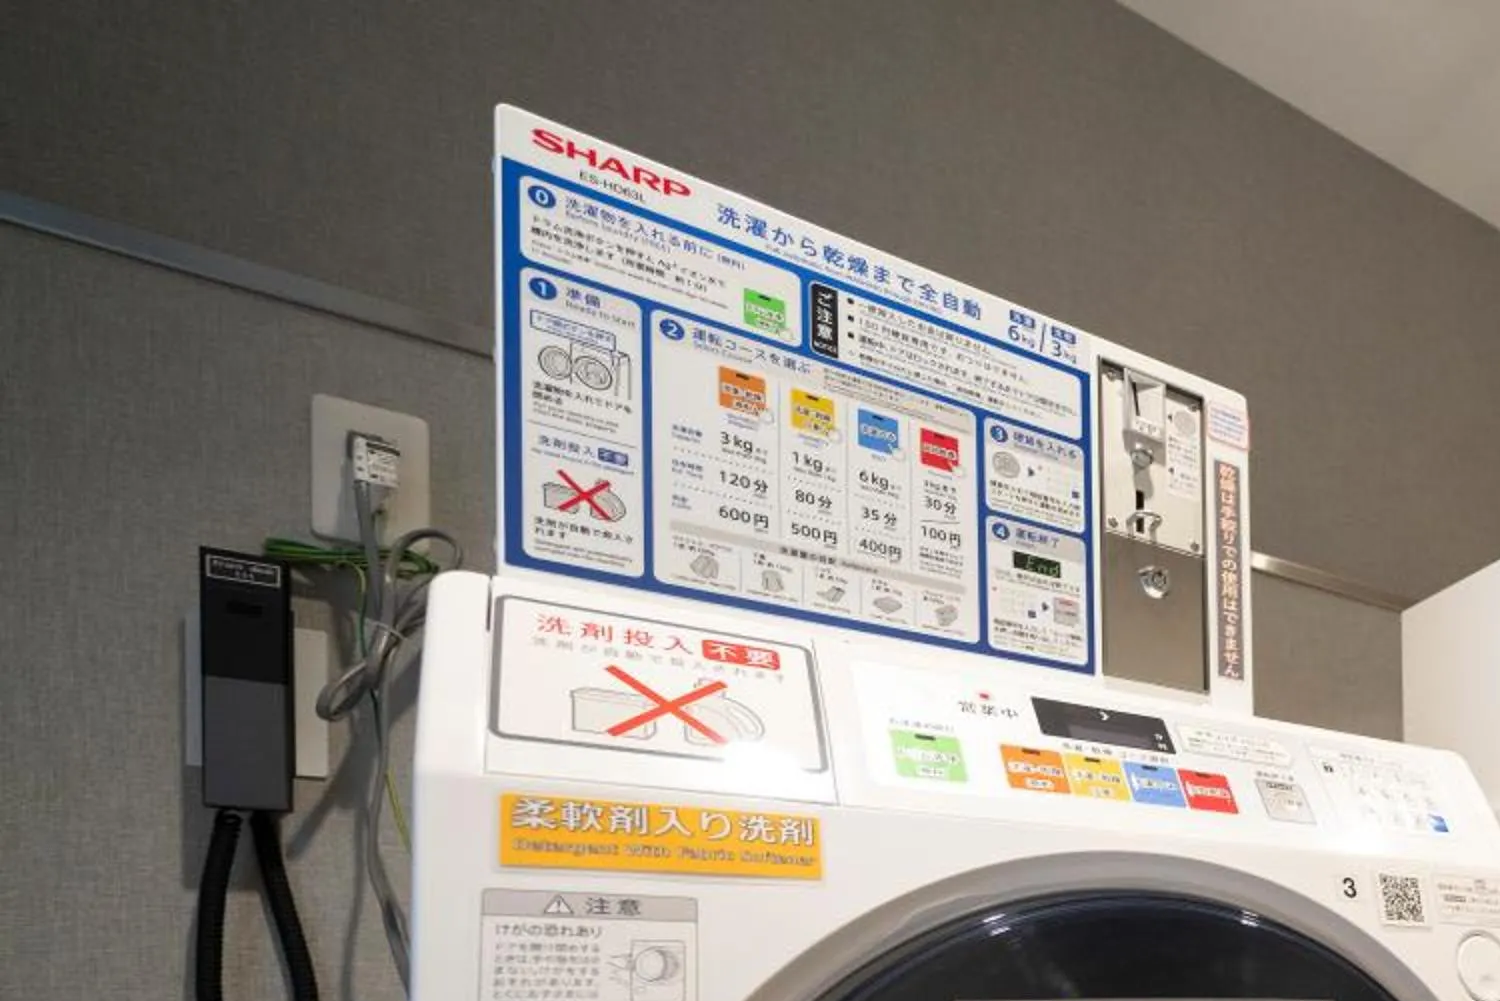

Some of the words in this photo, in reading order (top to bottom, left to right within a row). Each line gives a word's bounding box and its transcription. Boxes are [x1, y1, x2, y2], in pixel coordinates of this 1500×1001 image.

[532, 125, 690, 203] SHARP
[564, 194, 713, 260] 洗濯物を入れる前に
[716, 201, 981, 322] 洗濯から乾燥まで全自動
[566, 287, 600, 310] 準備
[816, 287, 832, 341] ご注意
[691, 326, 810, 376] 運転コースを選ぶ
[719, 470, 768, 495] 120分
[795, 489, 832, 510] 80分
[861, 505, 896, 526] 35分
[718, 503, 768, 529] 600円
[791, 520, 837, 545] 500円
[858, 536, 902, 559] 400円
[921, 524, 961, 548] 100円
[536, 613, 694, 656] 洗剤投入
[512, 798, 815, 847] 柔軟剤入り洗剤
[585, 897, 641, 916] 注意
[1342, 877, 1358, 898] 3
